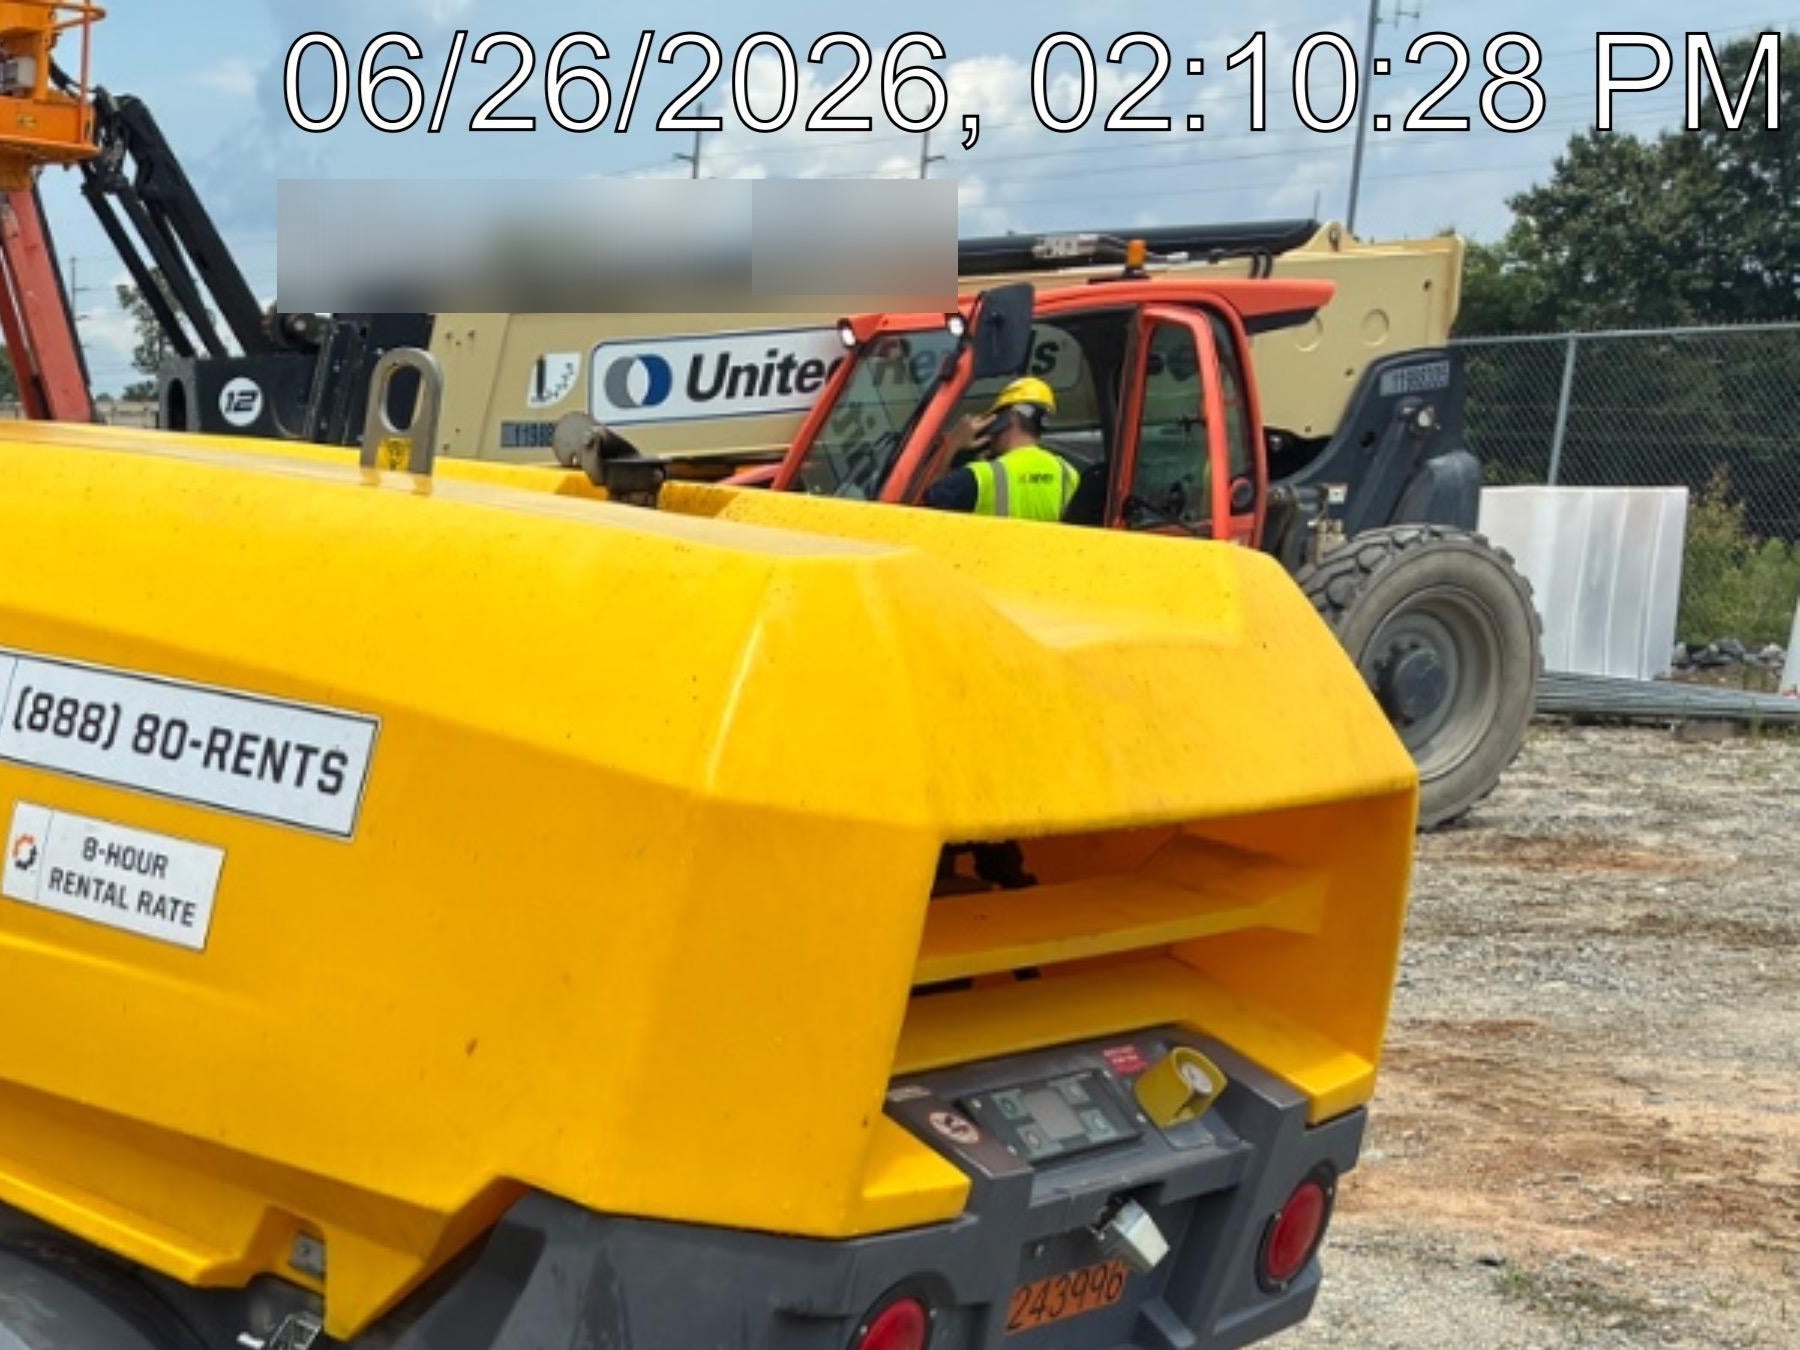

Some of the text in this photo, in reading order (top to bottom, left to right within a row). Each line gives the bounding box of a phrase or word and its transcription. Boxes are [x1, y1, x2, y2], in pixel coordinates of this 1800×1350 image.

[226, 389, 258, 413] 12
[687, 349, 845, 402] Unite
[13, 685, 349, 796] (888) 80-RENTS
[82, 836, 169, 879] 8-HOUR
[48, 867, 196, 928] RENTAL RATE
[1007, 1259, 1123, 1330] 243996
